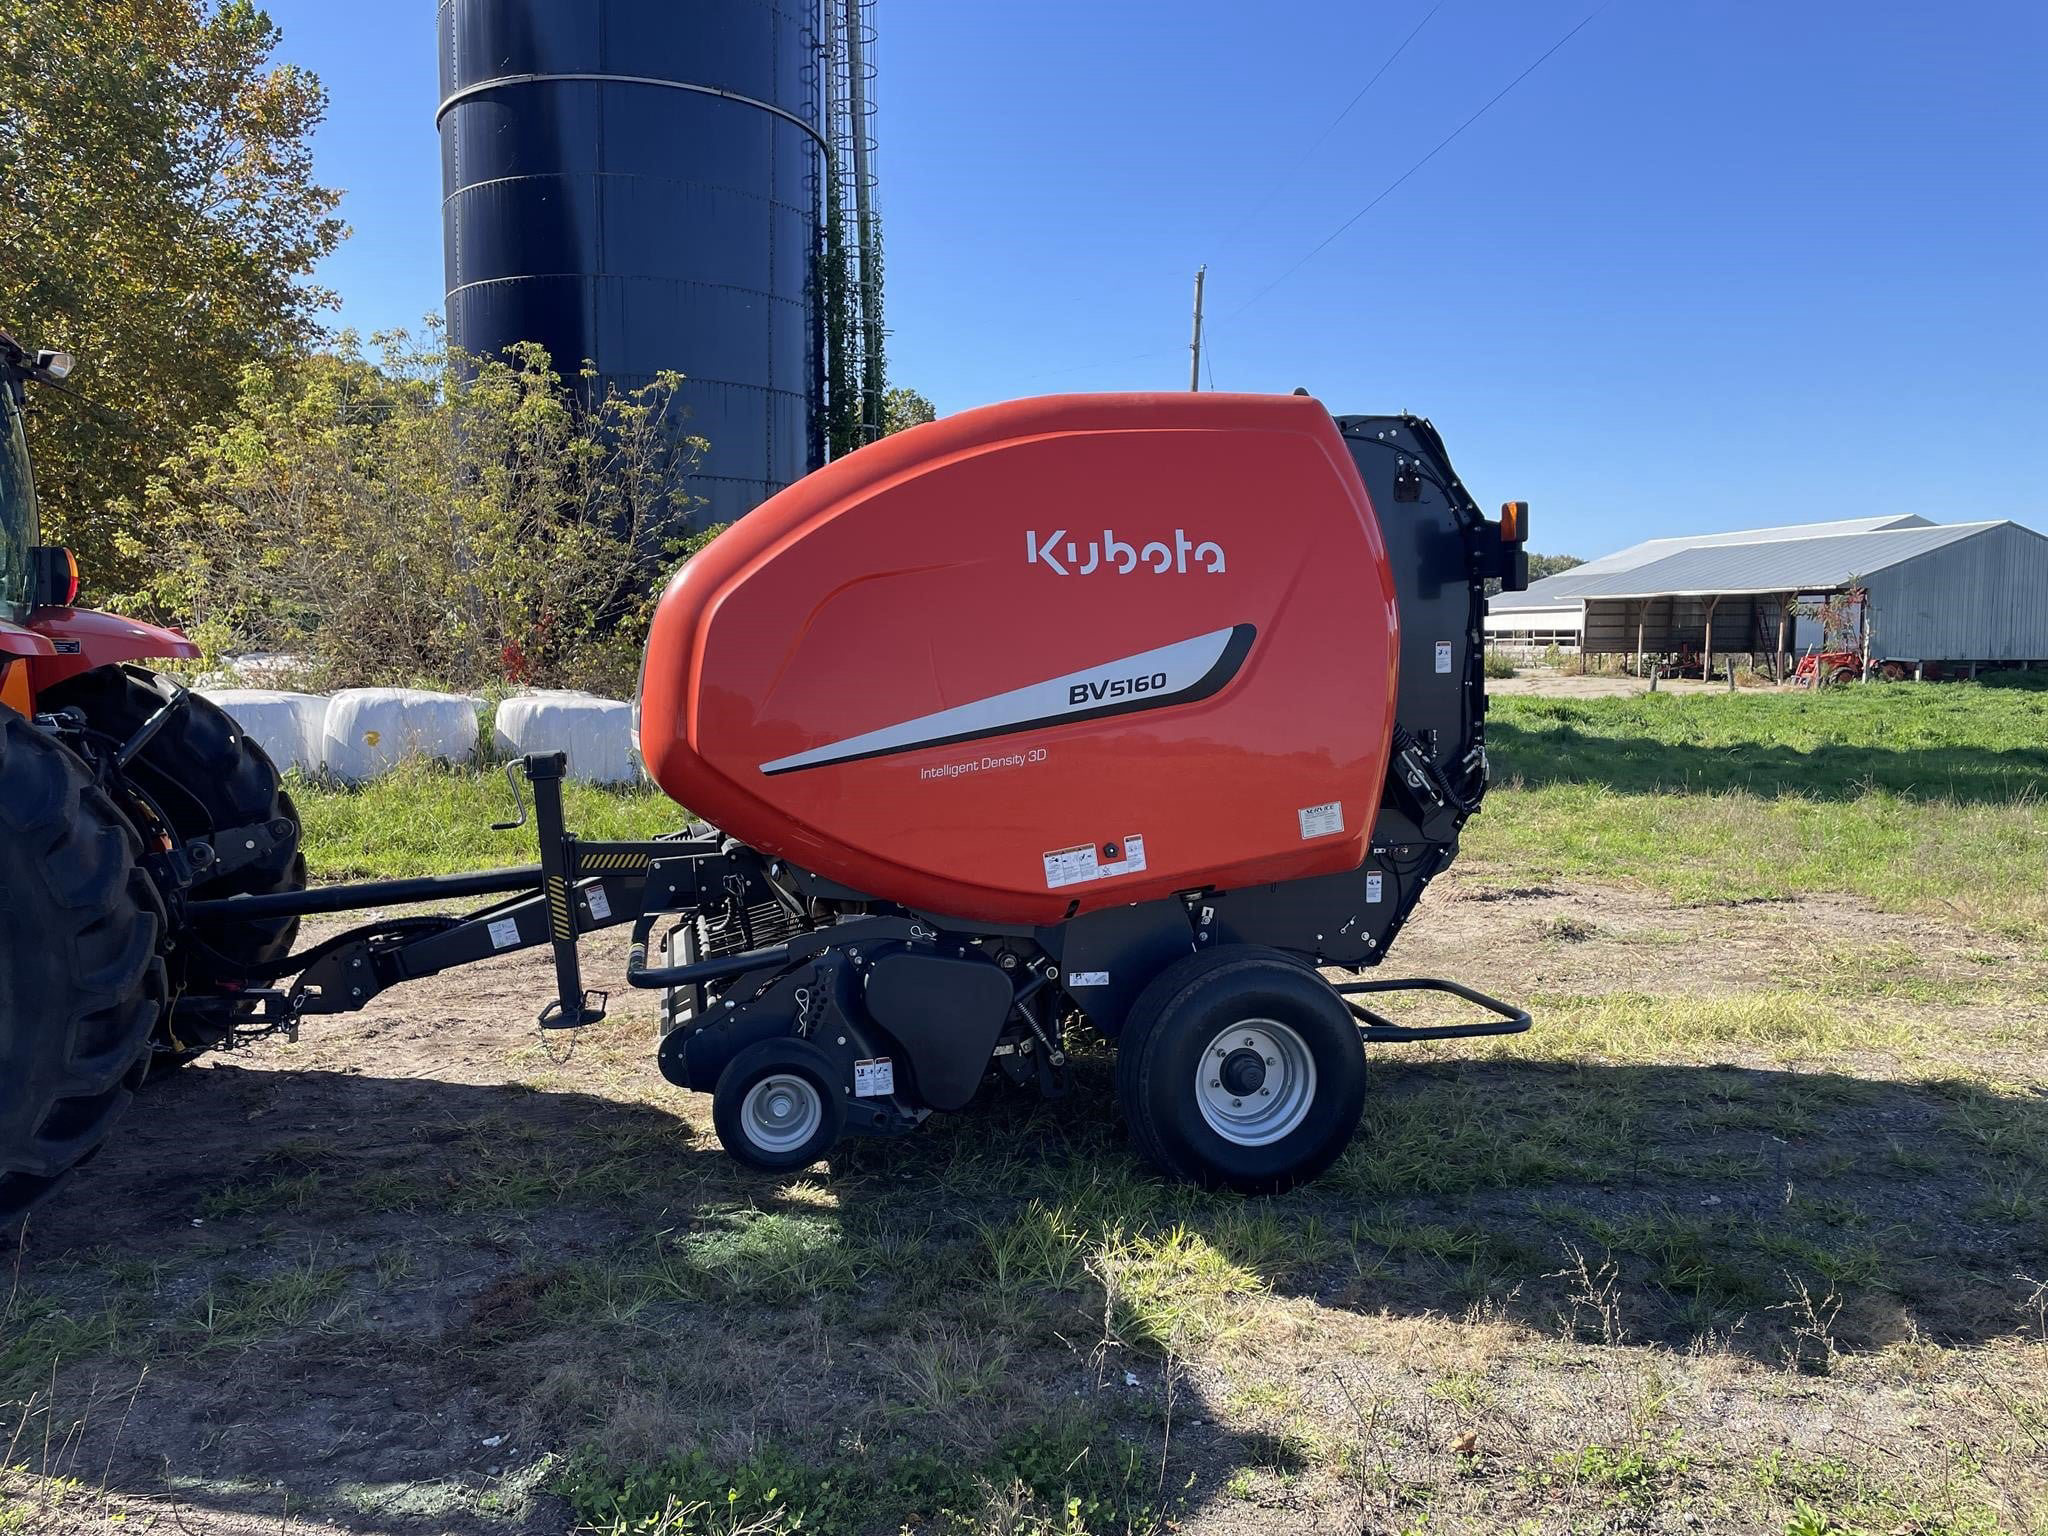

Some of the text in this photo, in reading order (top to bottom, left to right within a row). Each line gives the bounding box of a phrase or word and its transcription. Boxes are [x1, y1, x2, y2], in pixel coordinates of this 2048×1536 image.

[1026, 529, 1226, 576] Kubota
[1069, 672, 1167, 705] BV5160
[920, 748, 1047, 779] Intelligent Density 3D
